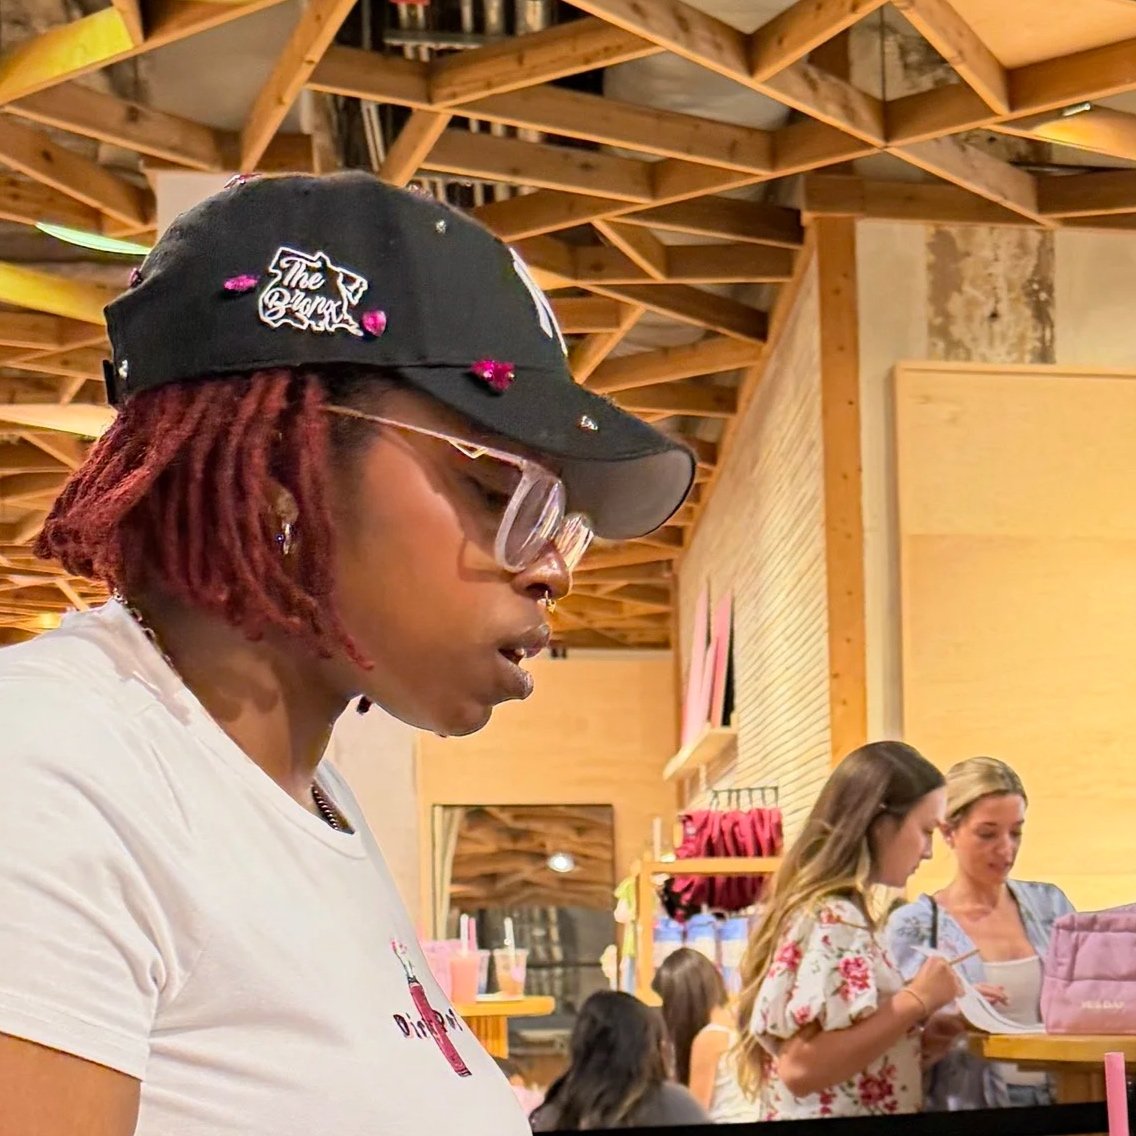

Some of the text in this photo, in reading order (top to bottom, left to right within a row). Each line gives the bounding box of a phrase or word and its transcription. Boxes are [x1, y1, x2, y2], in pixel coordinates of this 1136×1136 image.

[280, 256, 325, 290] The
[264, 287, 342, 324] Bronx
[1081, 1000, 1125, 1011] YES DAY
